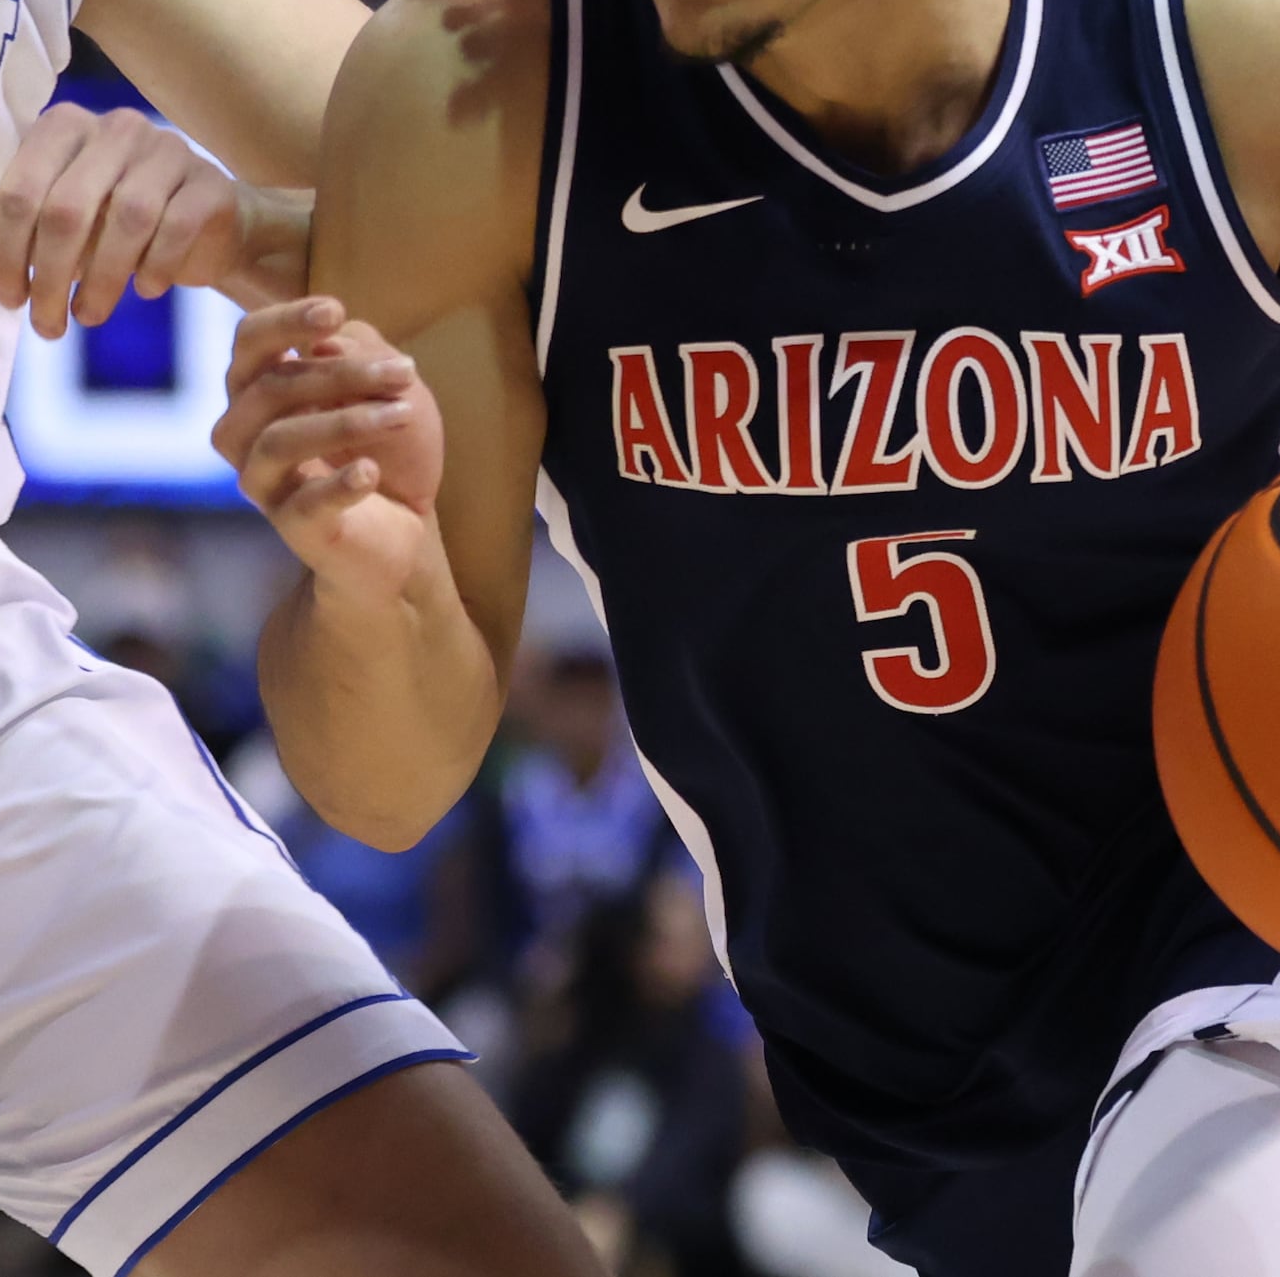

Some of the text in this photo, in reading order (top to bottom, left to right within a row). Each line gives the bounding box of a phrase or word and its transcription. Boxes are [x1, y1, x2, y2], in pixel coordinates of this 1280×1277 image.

[1070, 212, 1178, 287] XII
[609, 326, 1201, 495] ARIZONA
[846, 529, 996, 715] 5
